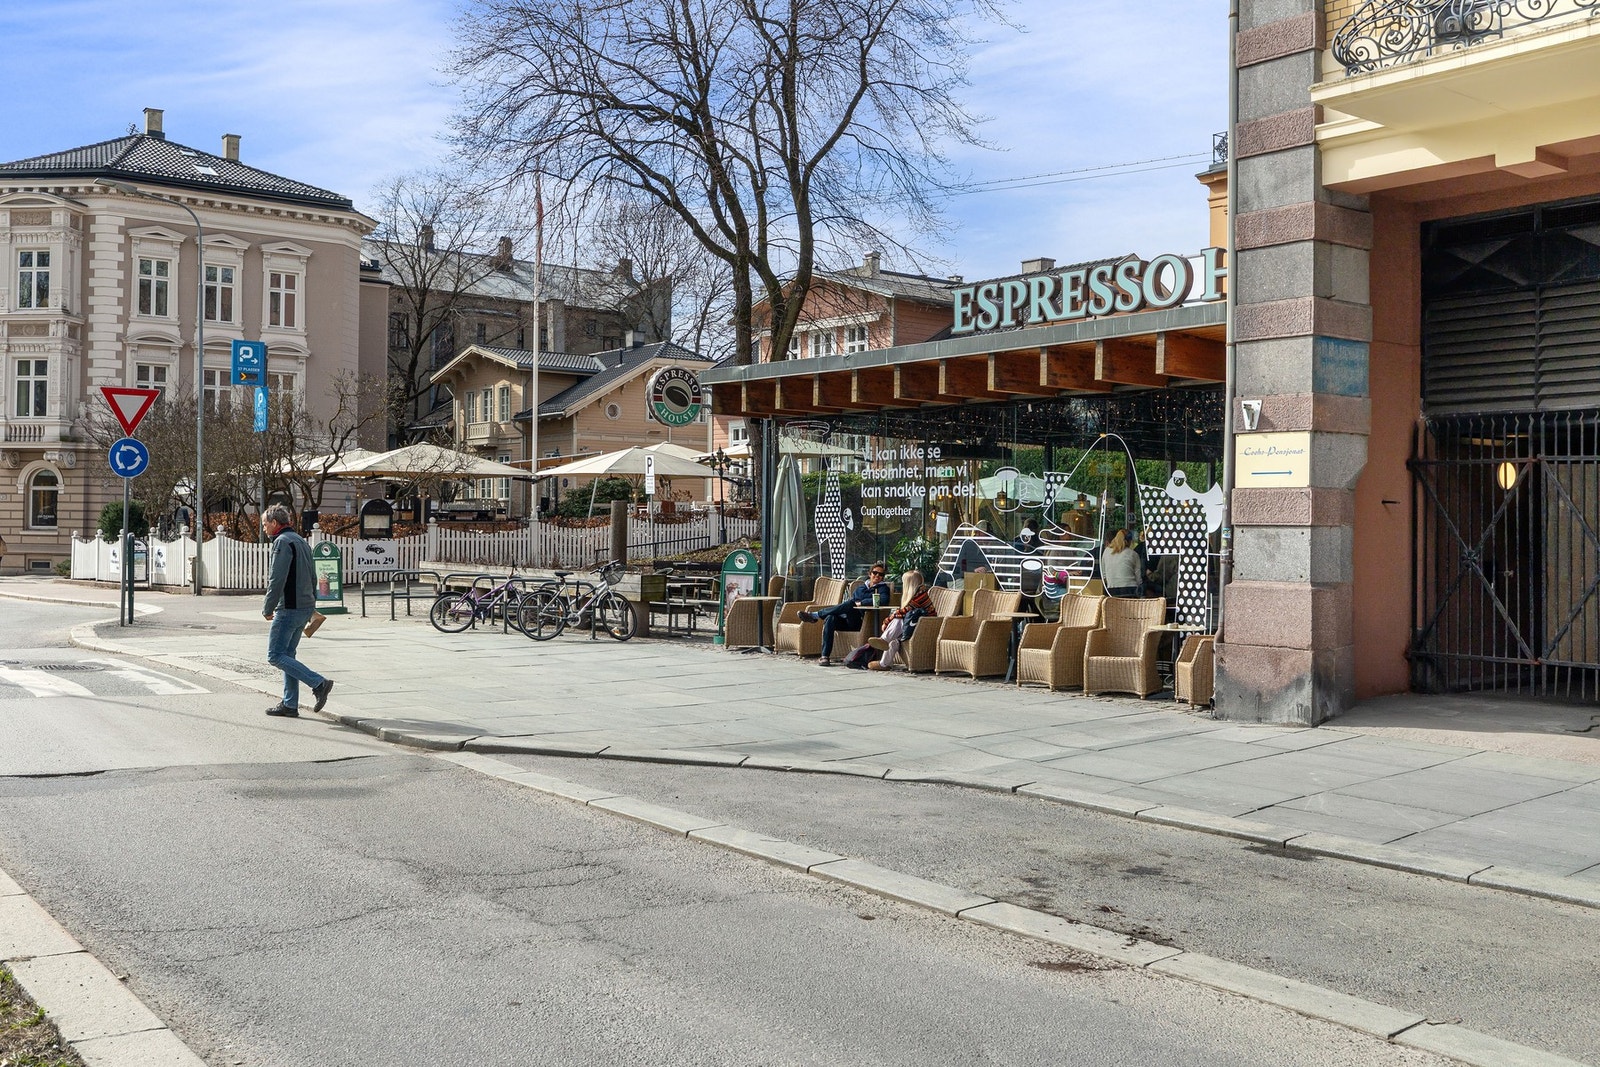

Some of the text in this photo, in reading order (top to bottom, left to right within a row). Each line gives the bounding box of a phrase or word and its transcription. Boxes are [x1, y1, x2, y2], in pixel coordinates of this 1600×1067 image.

[951, 253, 1193, 334] ESPRESSO
[655, 369, 699, 393] ESPRESSO
[660, 408, 695, 423] HOUSE
[875, 445, 897, 460] kan
[900, 445, 925, 460] ikke
[927, 446, 941, 459] se
[646, 456, 653, 474] P
[861, 460, 967, 480] ensomhet, men vi
[860, 483, 882, 498] kan
[884, 482, 926, 498] snakke
[929, 484, 949, 498] om
[860, 505, 913, 519] CupTogether
[357, 556, 395, 565] Park 29
